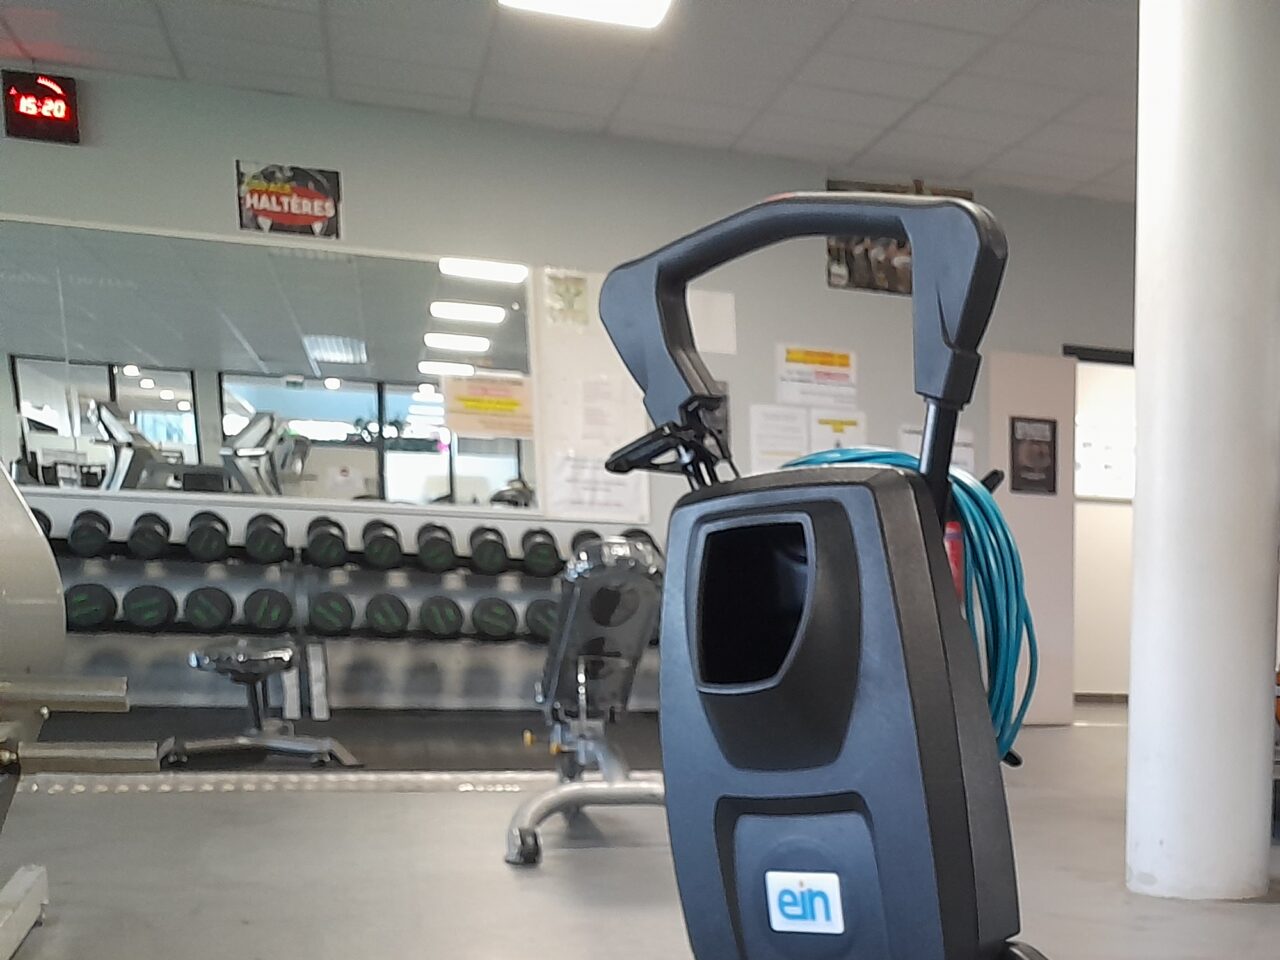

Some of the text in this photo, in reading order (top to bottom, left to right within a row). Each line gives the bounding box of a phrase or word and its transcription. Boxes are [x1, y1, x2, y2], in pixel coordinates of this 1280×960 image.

[19, 95, 66, 118] 15:20
[245, 191, 335, 218] HALTÈRES
[778, 881, 832, 921] ein
